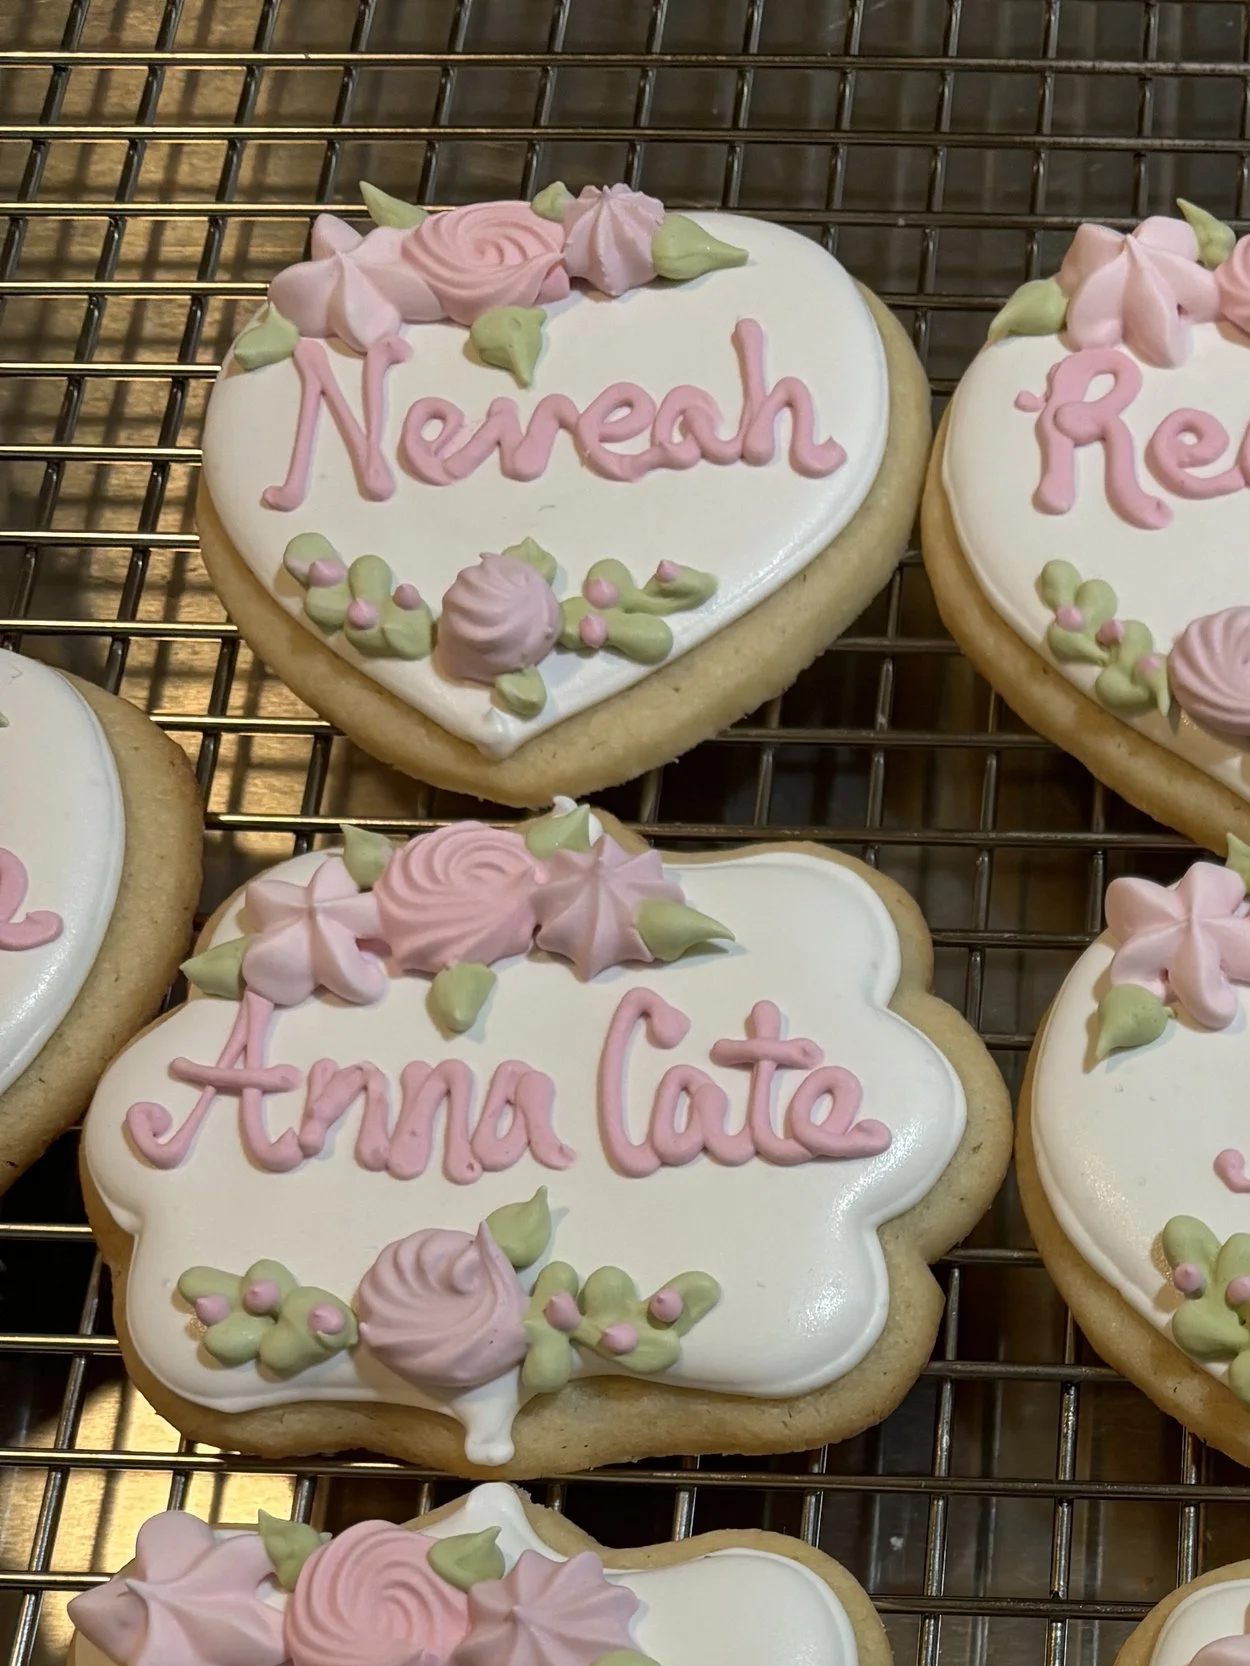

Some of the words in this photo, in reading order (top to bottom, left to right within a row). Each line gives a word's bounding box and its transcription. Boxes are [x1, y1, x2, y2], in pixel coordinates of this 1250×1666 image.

[262, 318, 847, 511] Neveah
[127, 990, 578, 1184] Anna
[601, 987, 892, 1177] Cate
